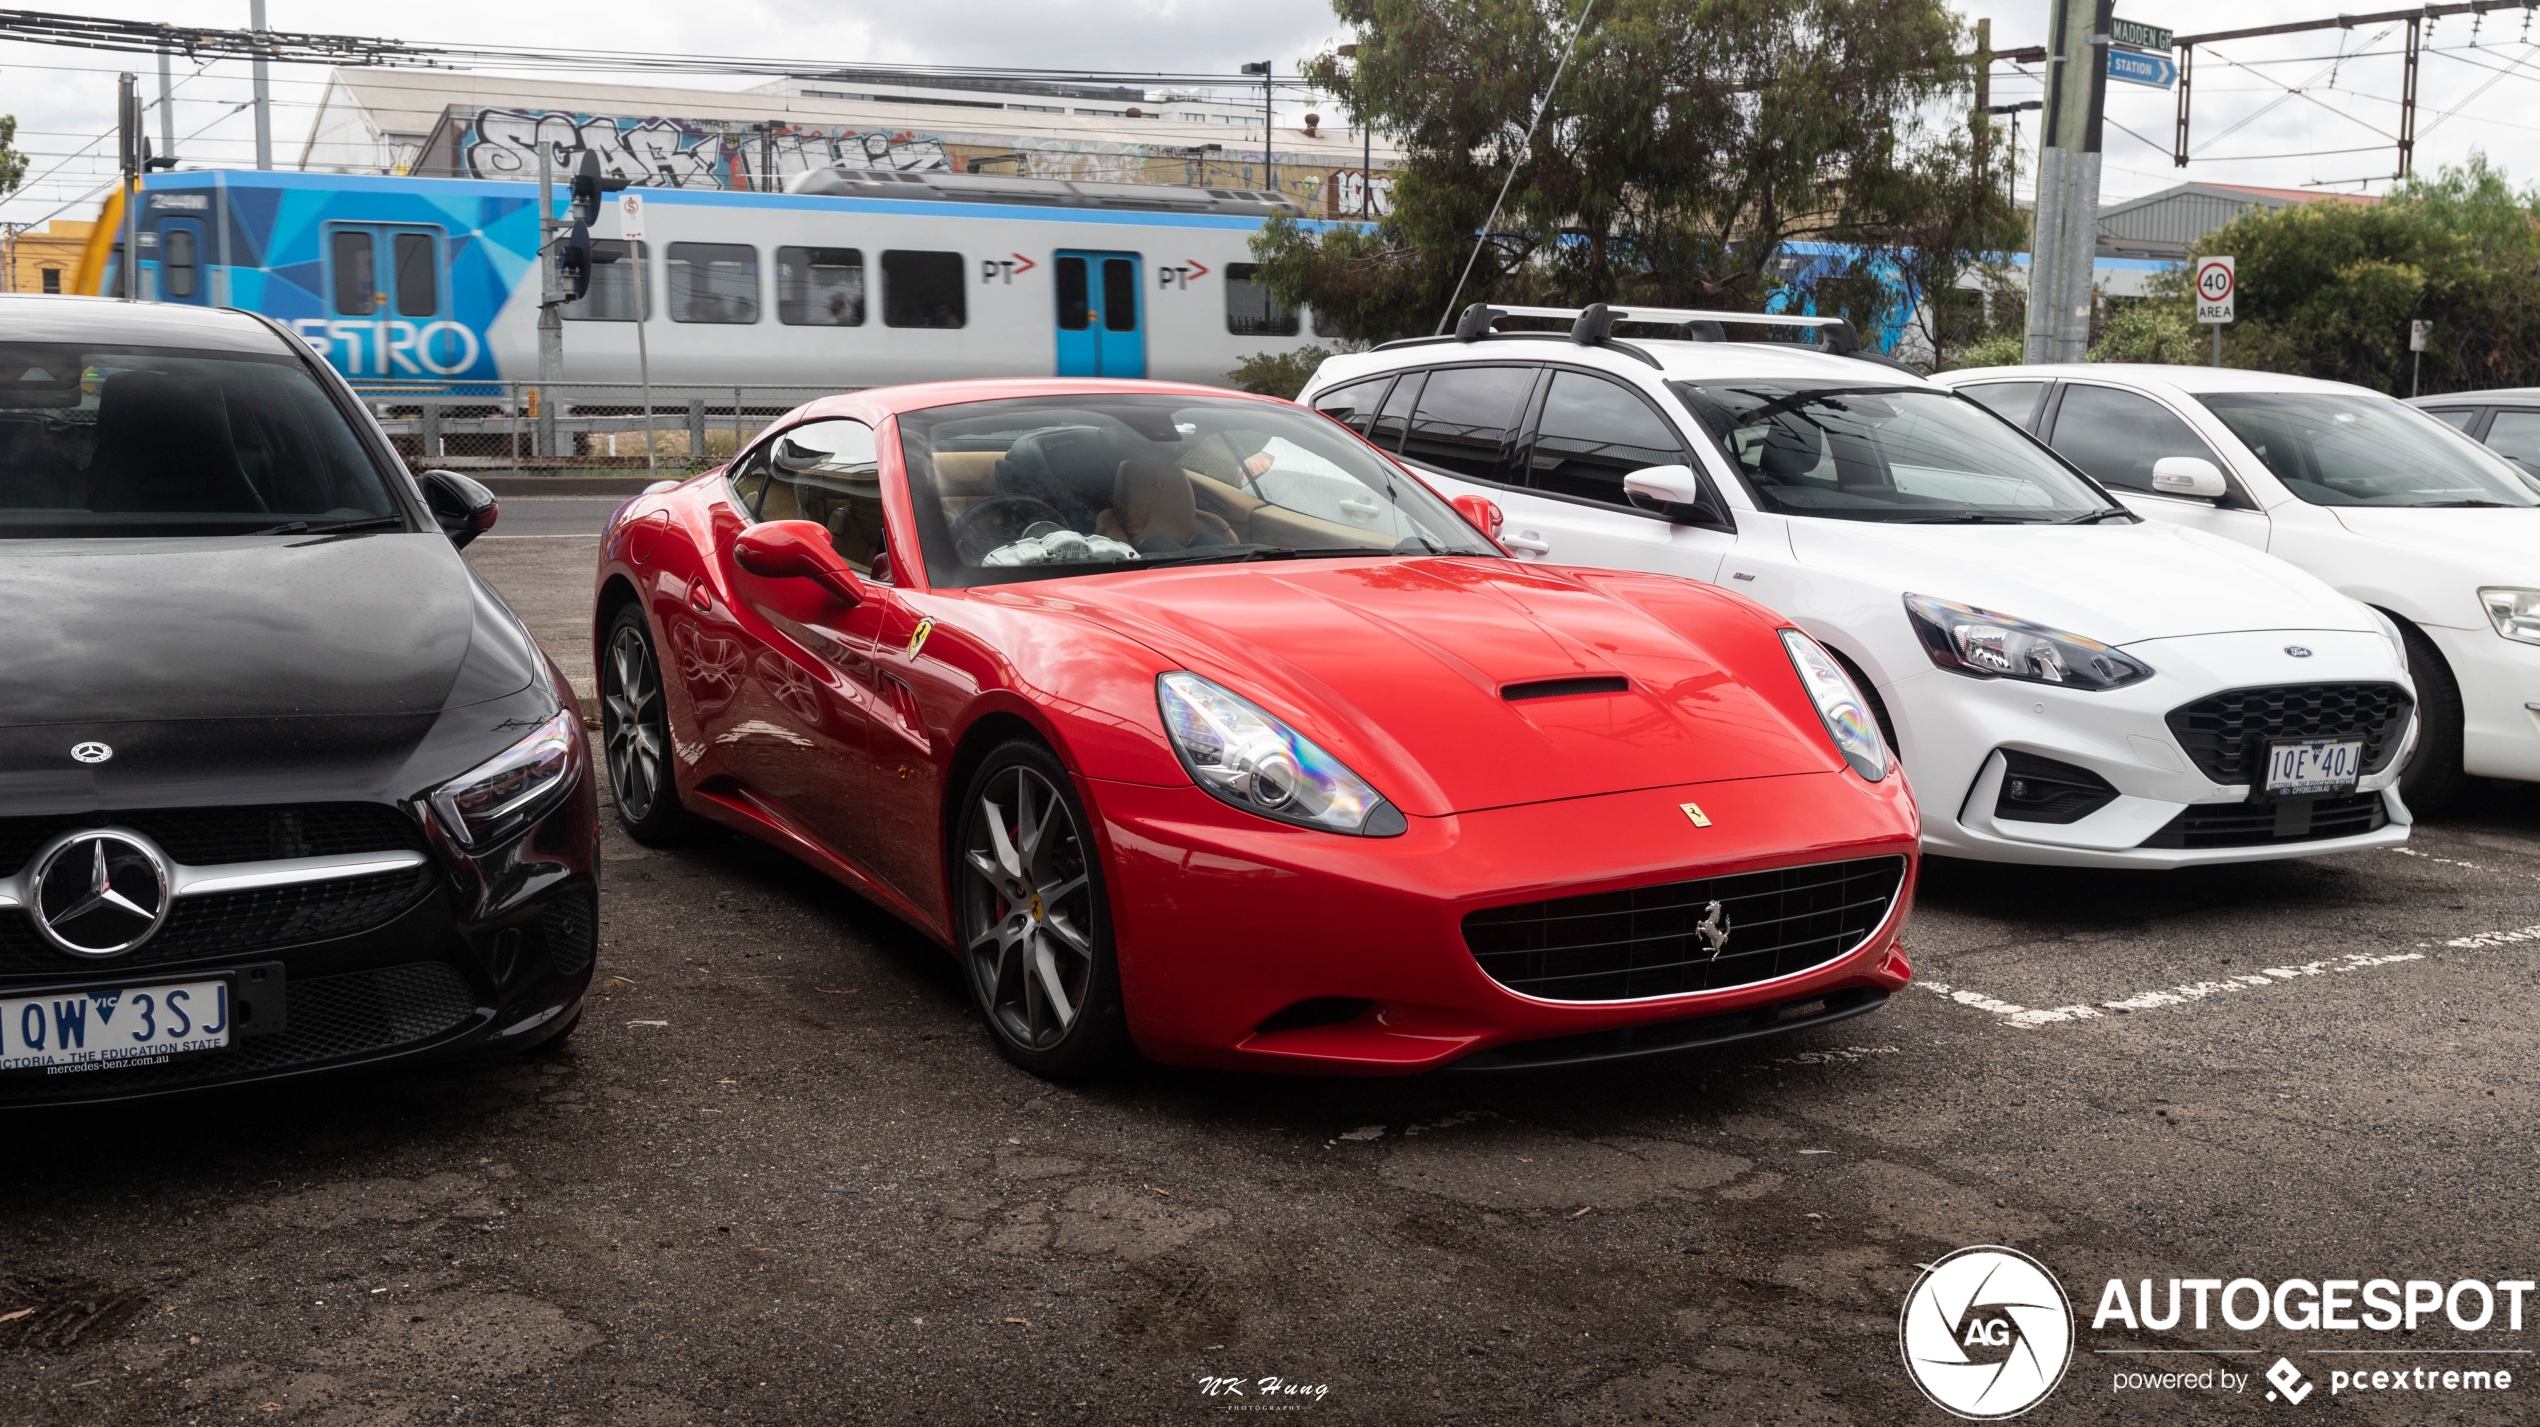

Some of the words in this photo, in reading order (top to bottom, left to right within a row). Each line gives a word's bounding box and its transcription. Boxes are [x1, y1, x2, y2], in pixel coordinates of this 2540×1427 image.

[2113, 20, 2156, 47] MADDEN
[2159, 31, 2172, 51] GR
[2115, 57, 2152, 76] STATION
[2203, 273, 2227, 291] 40
[2198, 305, 2232, 318] AREA
[278, 318, 480, 375] ETRO
[2273, 749, 2309, 781] 1QE
[2321, 746, 2360, 778] 40J
[91, 996, 118, 1008] VIC
[132, 984, 226, 1042] 3SJ
[0, 1055, 55, 1070] ICTORIA
[70, 1051, 96, 1063] THE
[101, 1043, 178, 1060] EDUCATION
[183, 1038, 222, 1052] STATE
[47, 1055, 169, 1075] mercedes-benz.com.au
